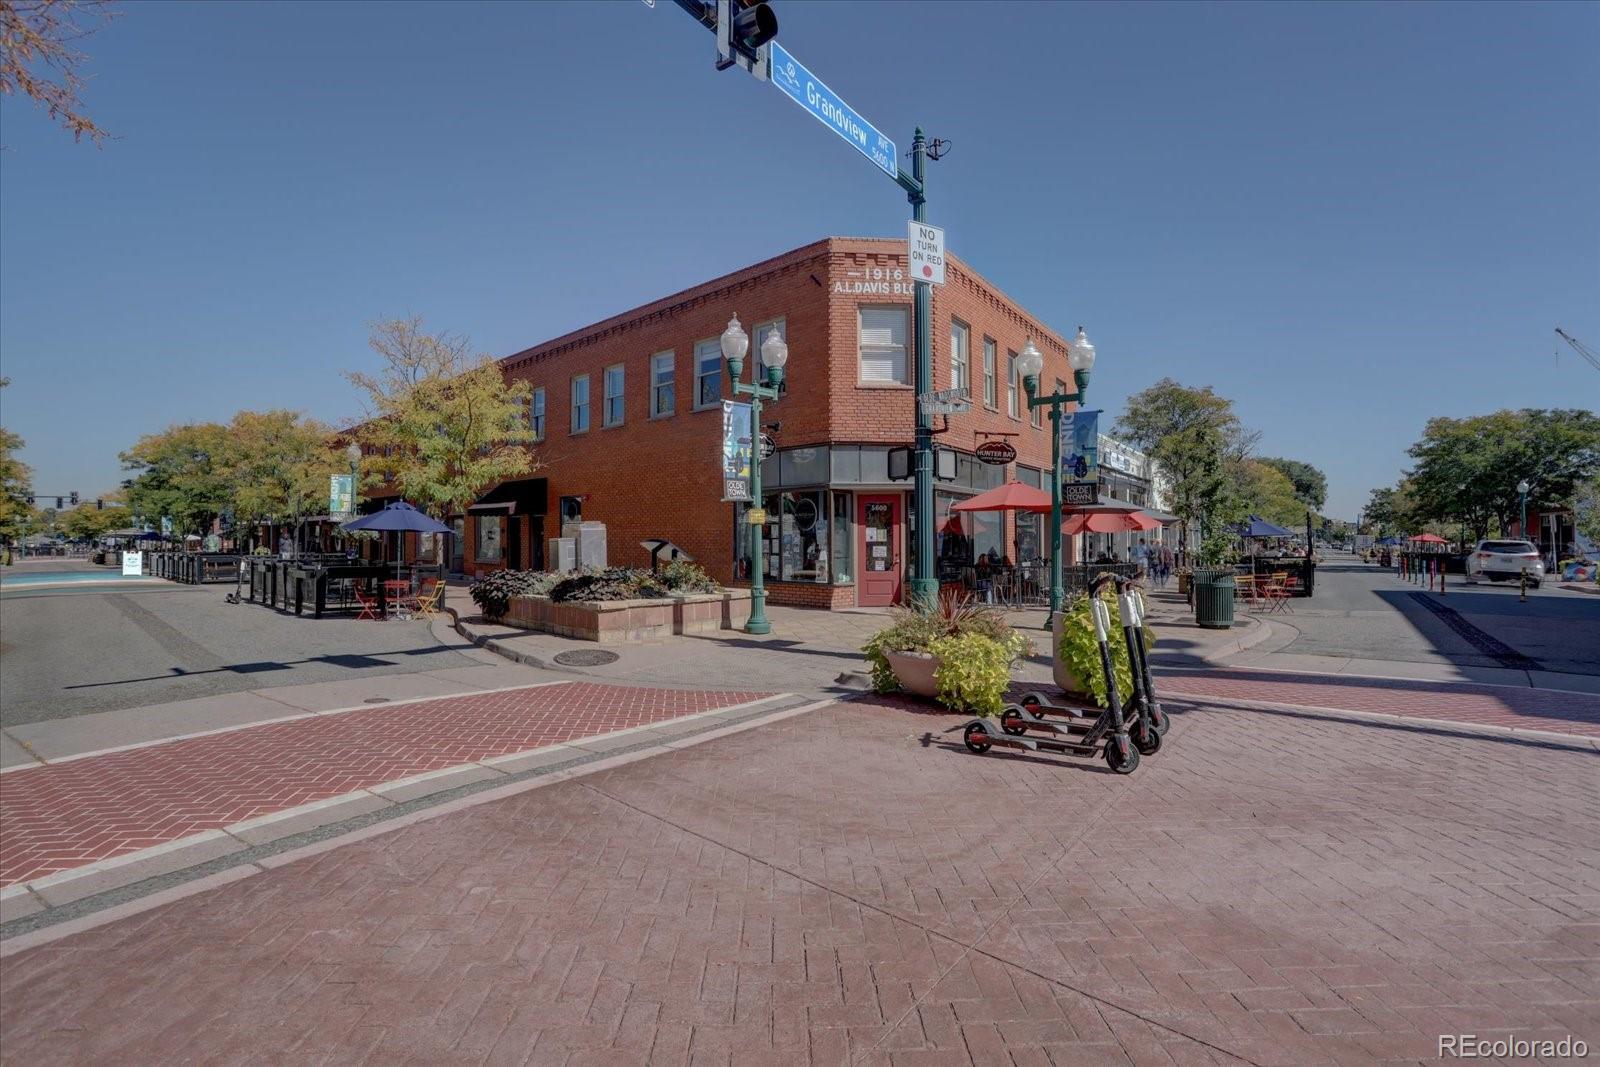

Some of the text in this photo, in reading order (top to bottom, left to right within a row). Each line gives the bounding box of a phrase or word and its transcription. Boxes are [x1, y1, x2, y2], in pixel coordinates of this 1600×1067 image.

[806, 81, 867, 146] Grandview
[872, 146, 888, 168] 5600
[919, 227, 935, 241] NO
[917, 239, 938, 254] TURN
[912, 250, 942, 266] ON RED
[865, 267, 903, 281] 1916
[976, 449, 1002, 457] HUNTER
[728, 489, 746, 497] TOWN
[1068, 486, 1089, 494] OLDE
[1068, 494, 1092, 502] TOWN
